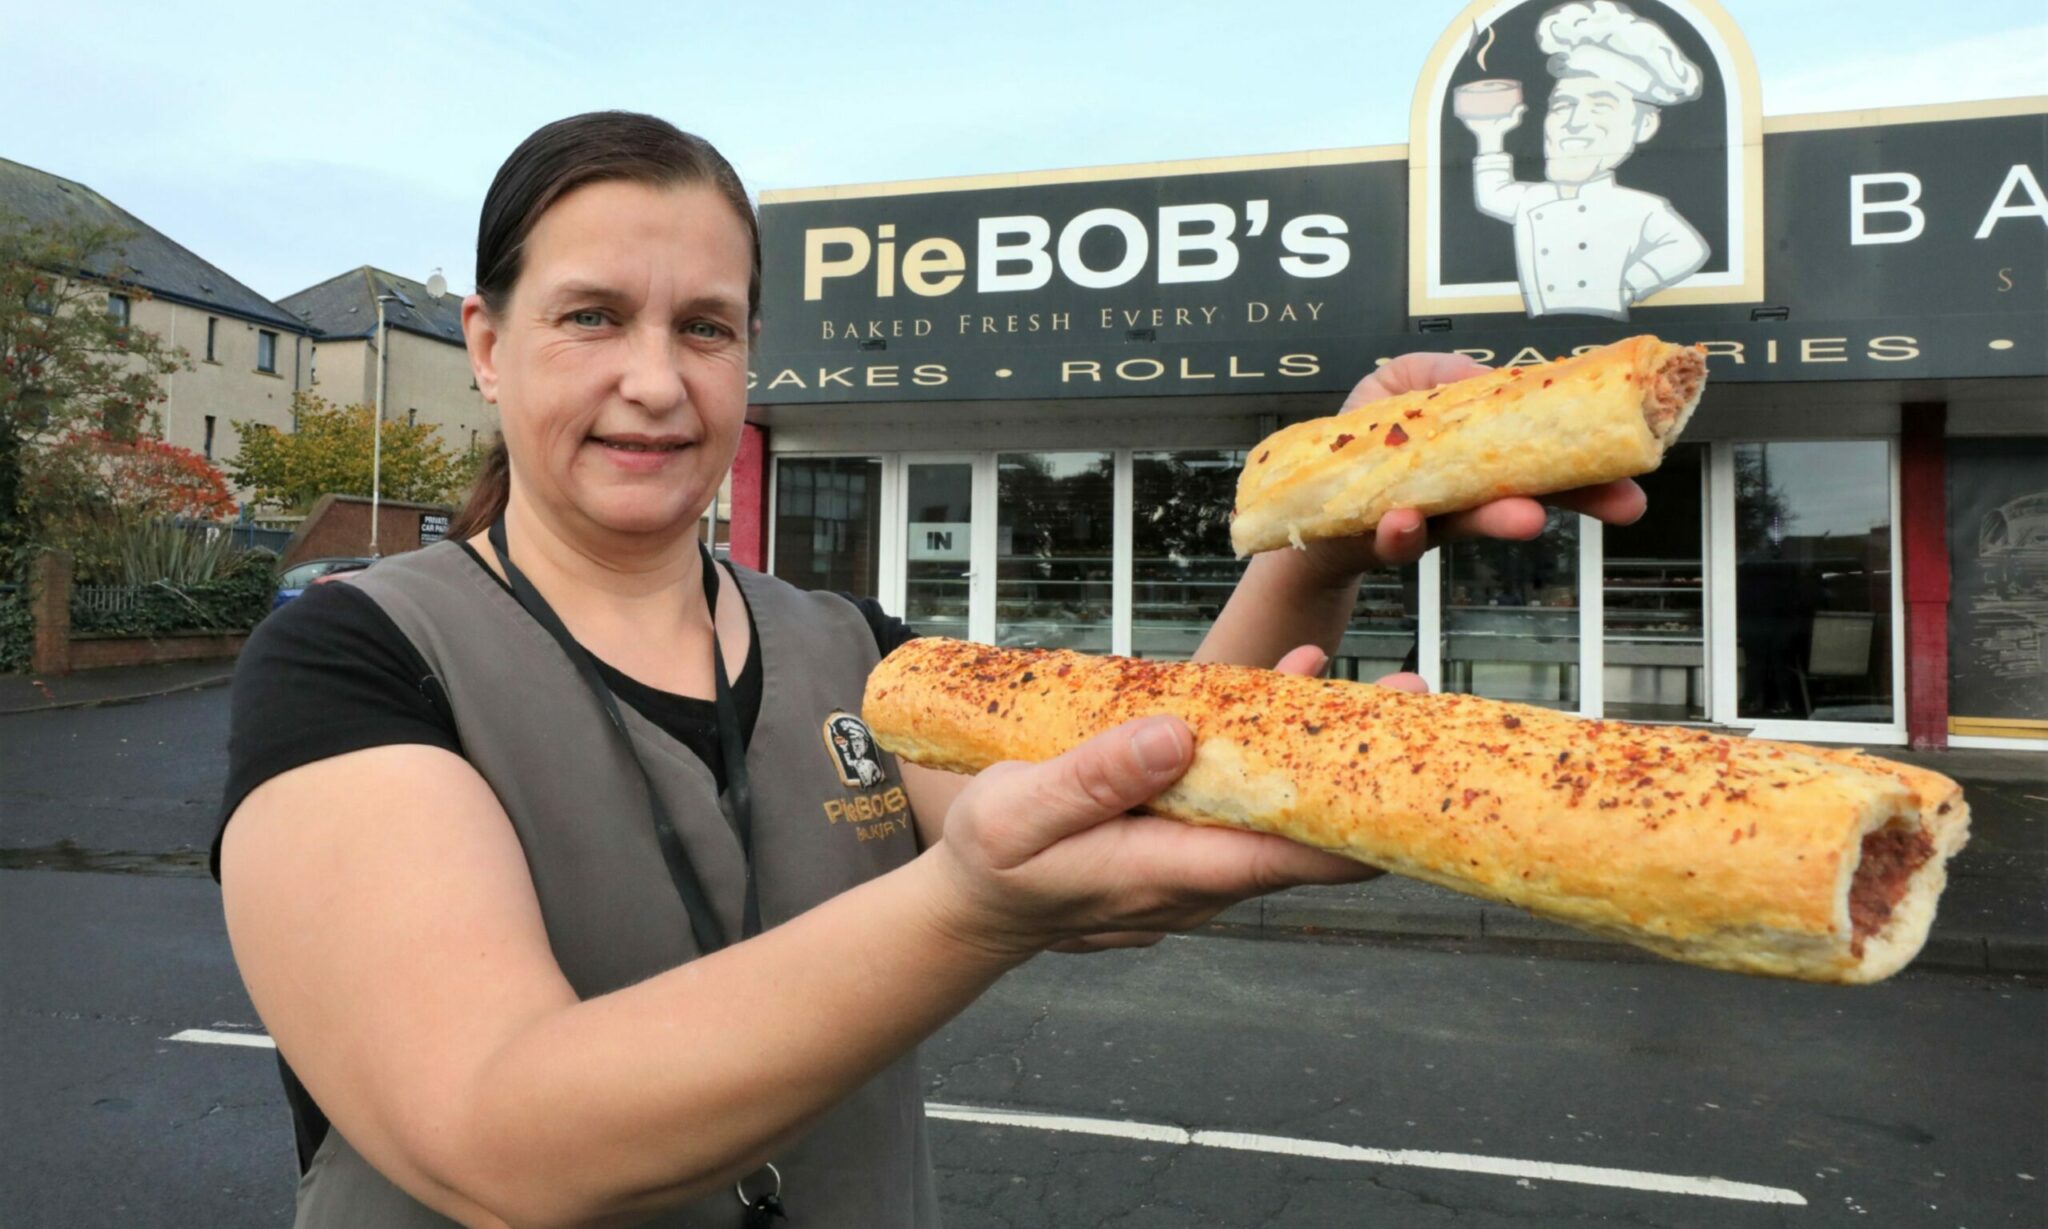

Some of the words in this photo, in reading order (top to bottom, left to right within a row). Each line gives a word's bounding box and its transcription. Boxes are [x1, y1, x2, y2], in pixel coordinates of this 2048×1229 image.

[822, 319, 932, 340] BAKED
[959, 312, 1072, 335] FRESH
[1100, 306, 1218, 328] EVERY
[1247, 302, 1325, 323] DAY
[1061, 353, 1321, 383] ROLLS
[1453, 335, 1920, 370] PARIES
[421, 523, 434, 532] CAR
[424, 515, 448, 525] PRIVATE
[927, 531, 952, 550] IN
